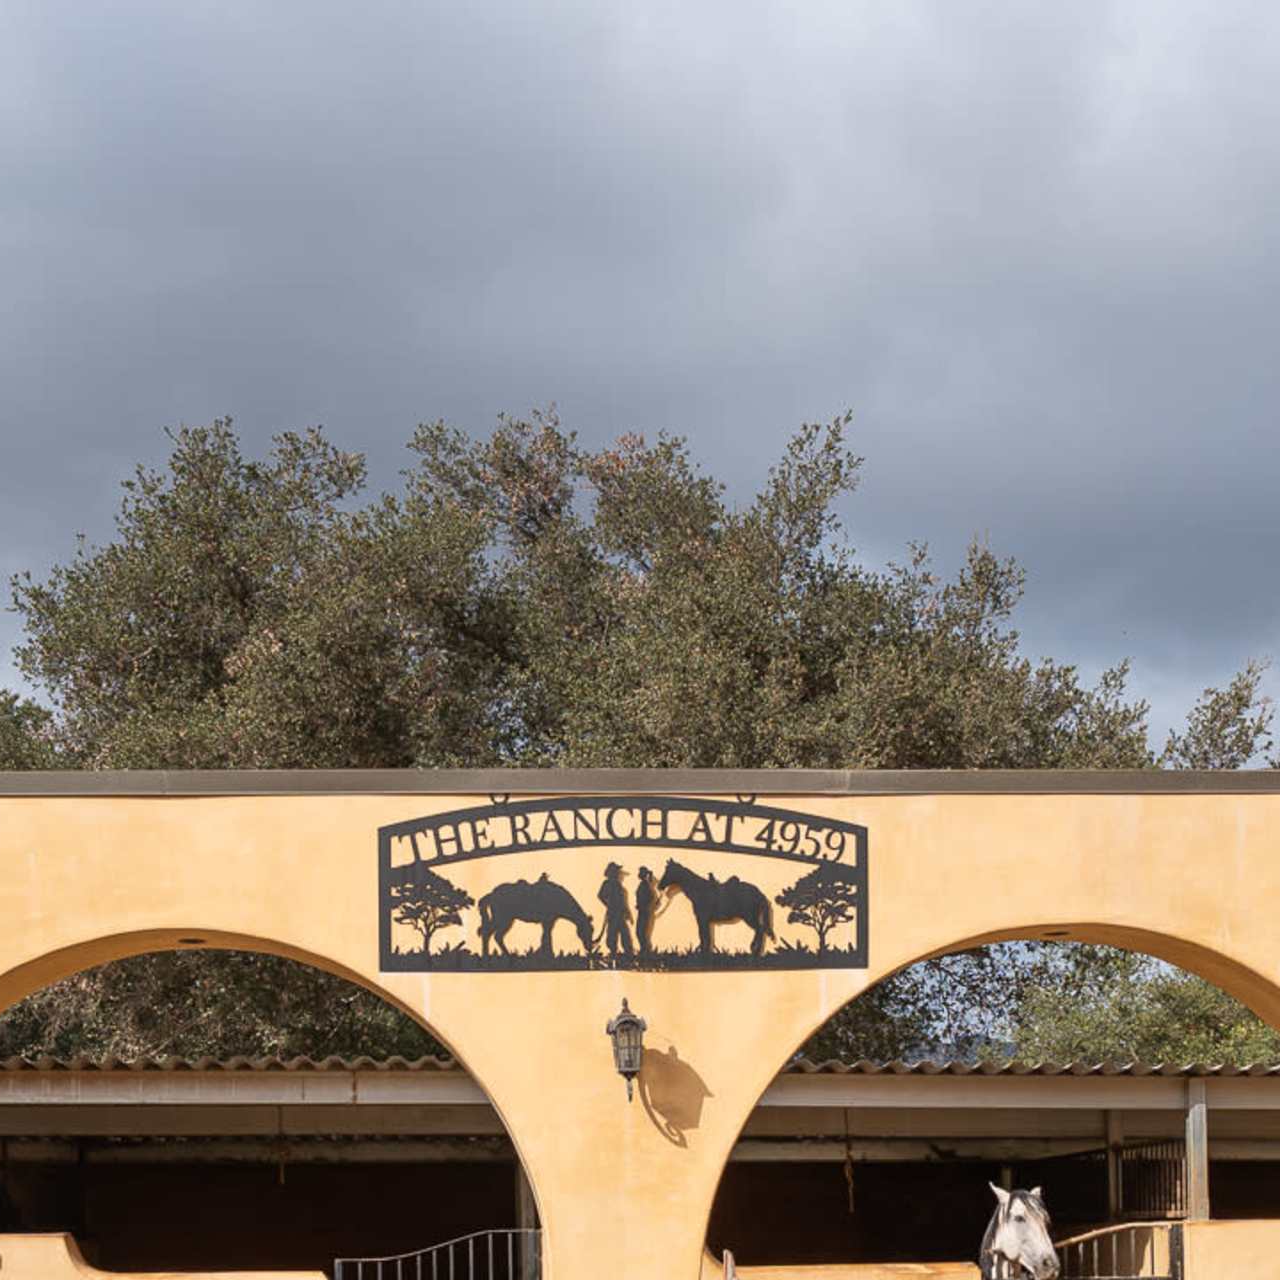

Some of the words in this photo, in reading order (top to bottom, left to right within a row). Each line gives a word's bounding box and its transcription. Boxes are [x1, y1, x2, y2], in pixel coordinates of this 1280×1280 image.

[397, 818, 496, 866] THE
[511, 807, 669, 845] RANCH
[685, 811, 745, 847] AT
[754, 819, 846, 864] 4959
